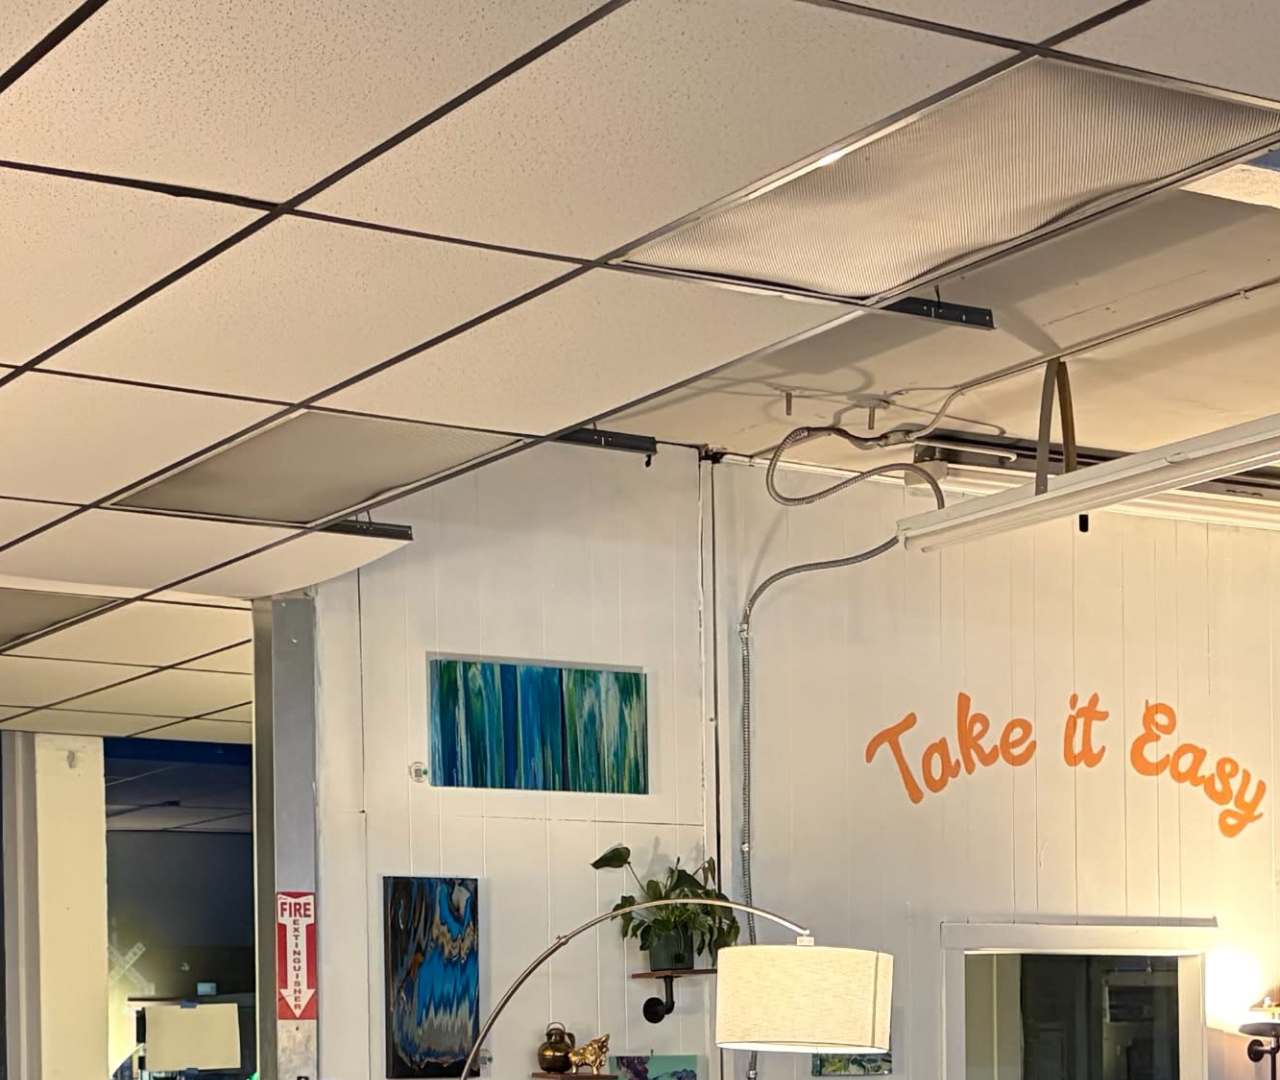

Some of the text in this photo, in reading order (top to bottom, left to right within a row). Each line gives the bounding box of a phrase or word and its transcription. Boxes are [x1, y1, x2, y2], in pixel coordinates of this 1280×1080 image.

[865, 692, 1266, 838] Take it Easy
[280, 902, 312, 918] FIRE
[292, 919, 302, 1010] EXTINGUISHER
